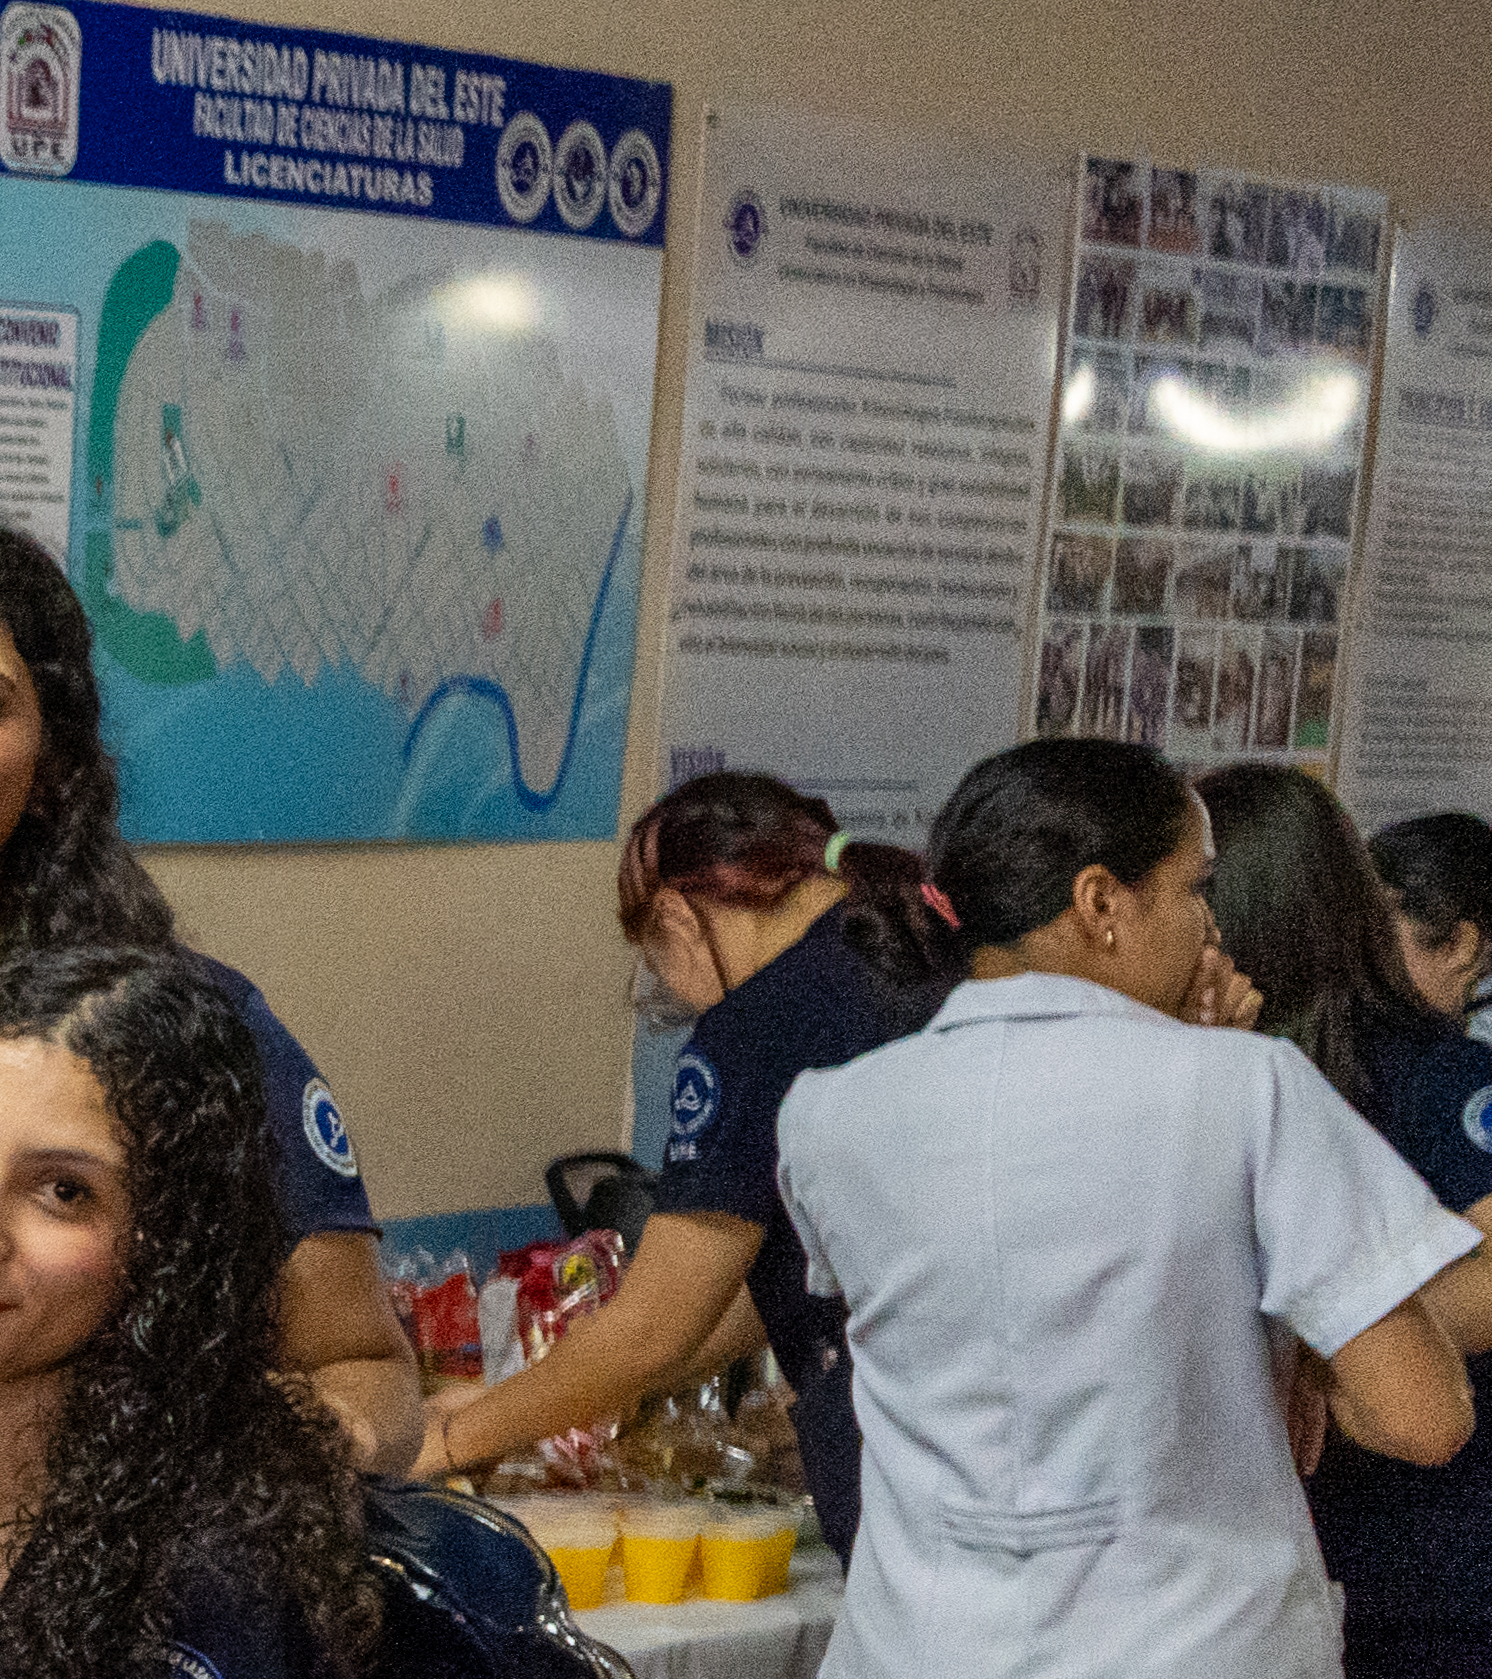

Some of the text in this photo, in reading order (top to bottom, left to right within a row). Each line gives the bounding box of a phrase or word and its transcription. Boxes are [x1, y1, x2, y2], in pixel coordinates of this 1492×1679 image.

[151, 28, 508, 127] UNIVERSIDAD PRIVADA DEL ESTE
[223, 149, 434, 206] LICENCIATURAS
